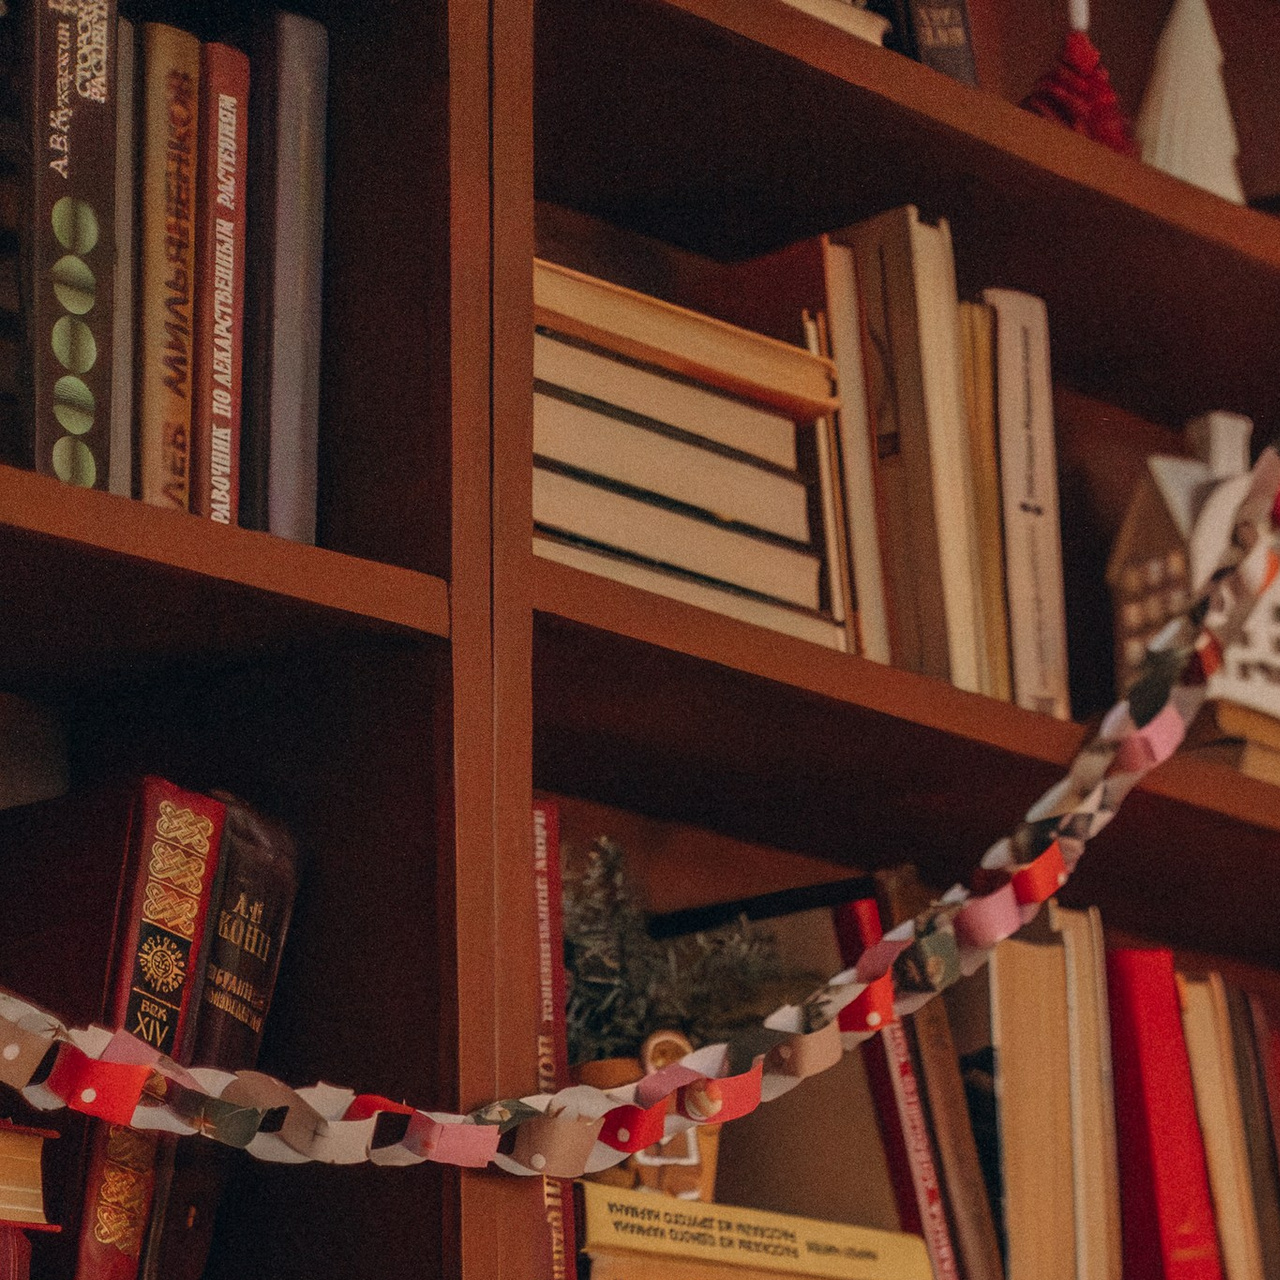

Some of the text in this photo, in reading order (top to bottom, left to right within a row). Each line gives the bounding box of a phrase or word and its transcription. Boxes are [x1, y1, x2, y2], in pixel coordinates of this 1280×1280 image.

[216, 94, 239, 210] РАСТЕНИЯМ
[212, 220, 236, 388] ЛЕКАРСТВЕННЫМ
[211, 390, 232, 419] ПО
[162, 423, 189, 509] ЛЕВ
[133, 1011, 169, 1048] XIV
